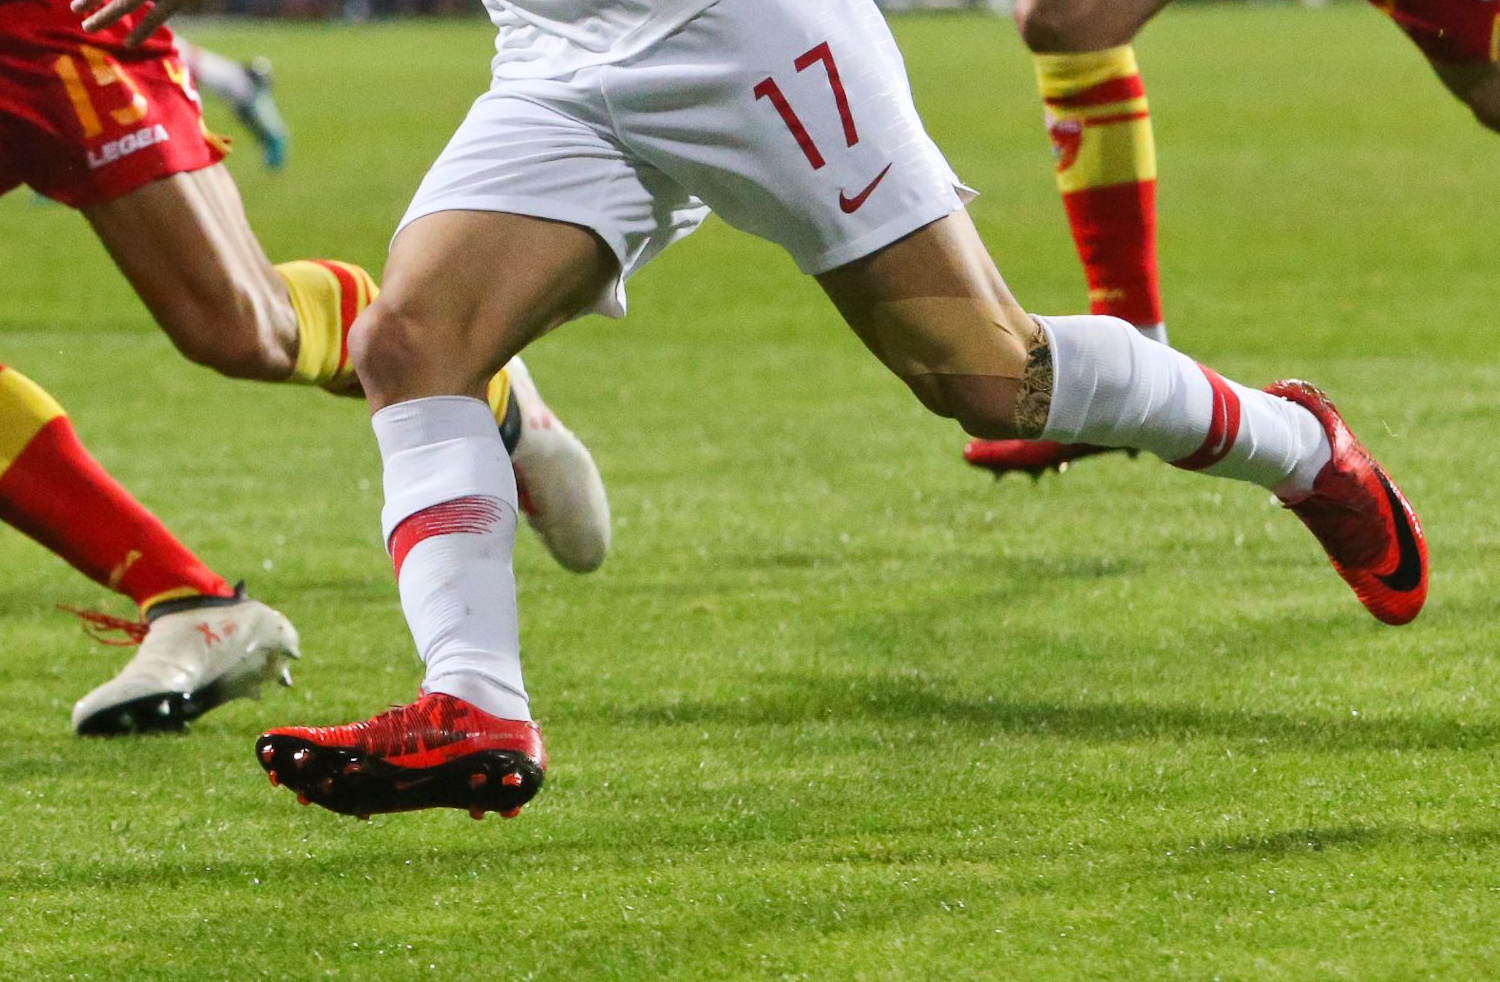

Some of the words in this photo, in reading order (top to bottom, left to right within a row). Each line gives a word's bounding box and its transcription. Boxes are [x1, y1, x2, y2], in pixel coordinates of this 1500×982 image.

[54, 43, 150, 139] 15
[753, 40, 860, 171] 17
[87, 123, 170, 169] LEGEA
